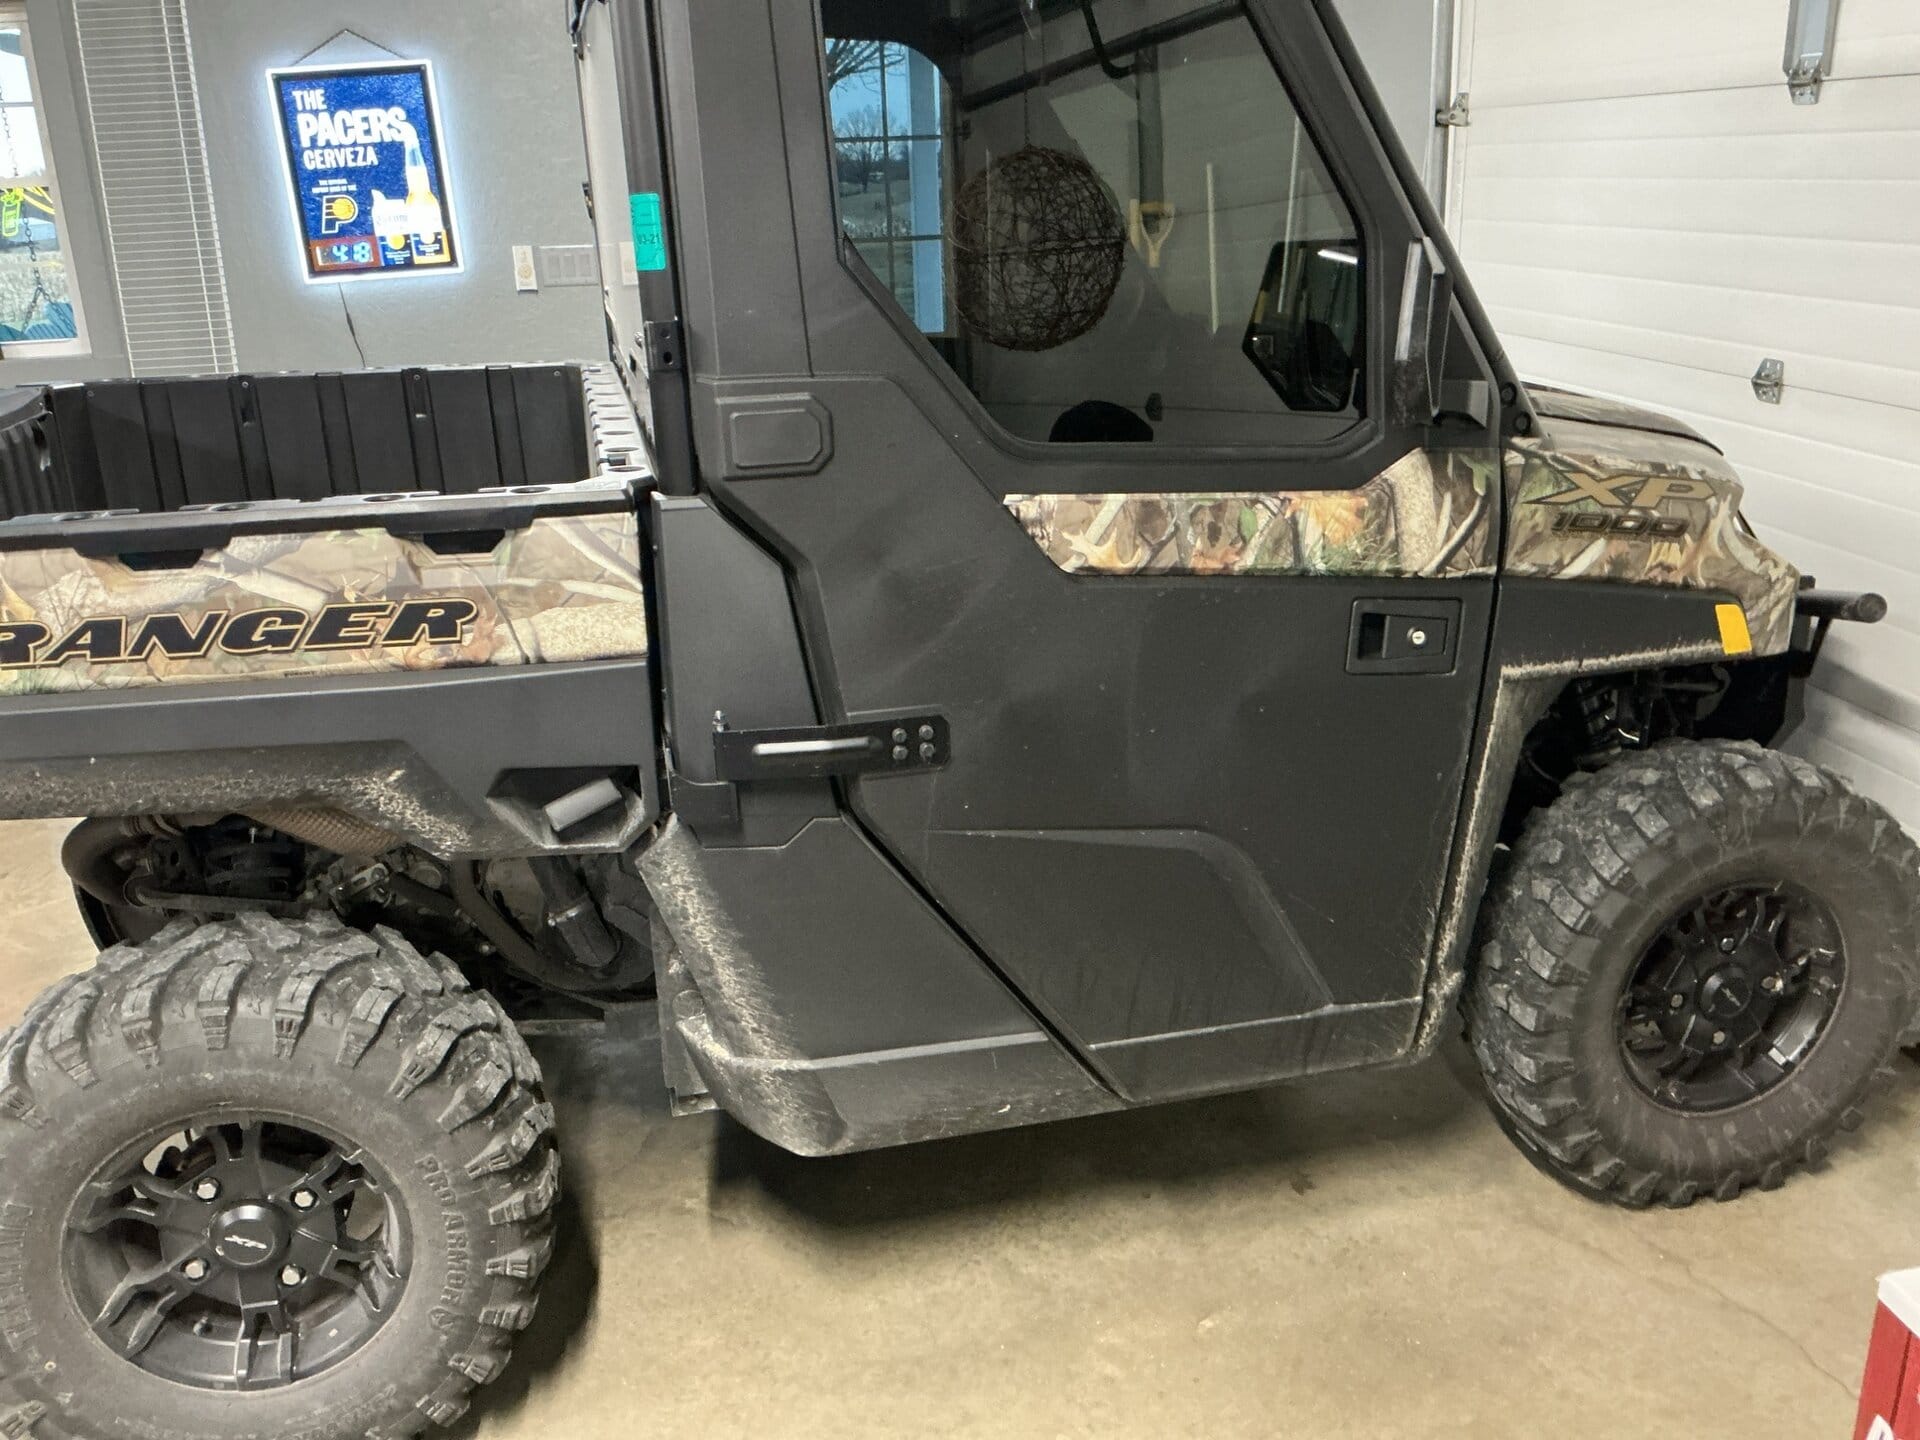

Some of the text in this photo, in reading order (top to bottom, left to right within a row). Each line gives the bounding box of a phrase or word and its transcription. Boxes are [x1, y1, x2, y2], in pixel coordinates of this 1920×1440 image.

[292, 88, 327, 111] THE
[297, 106, 409, 148] PACERS
[303, 146, 379, 170] CERVEZA
[1524, 469, 1717, 509] XP
[1551, 511, 1690, 538] 1000
